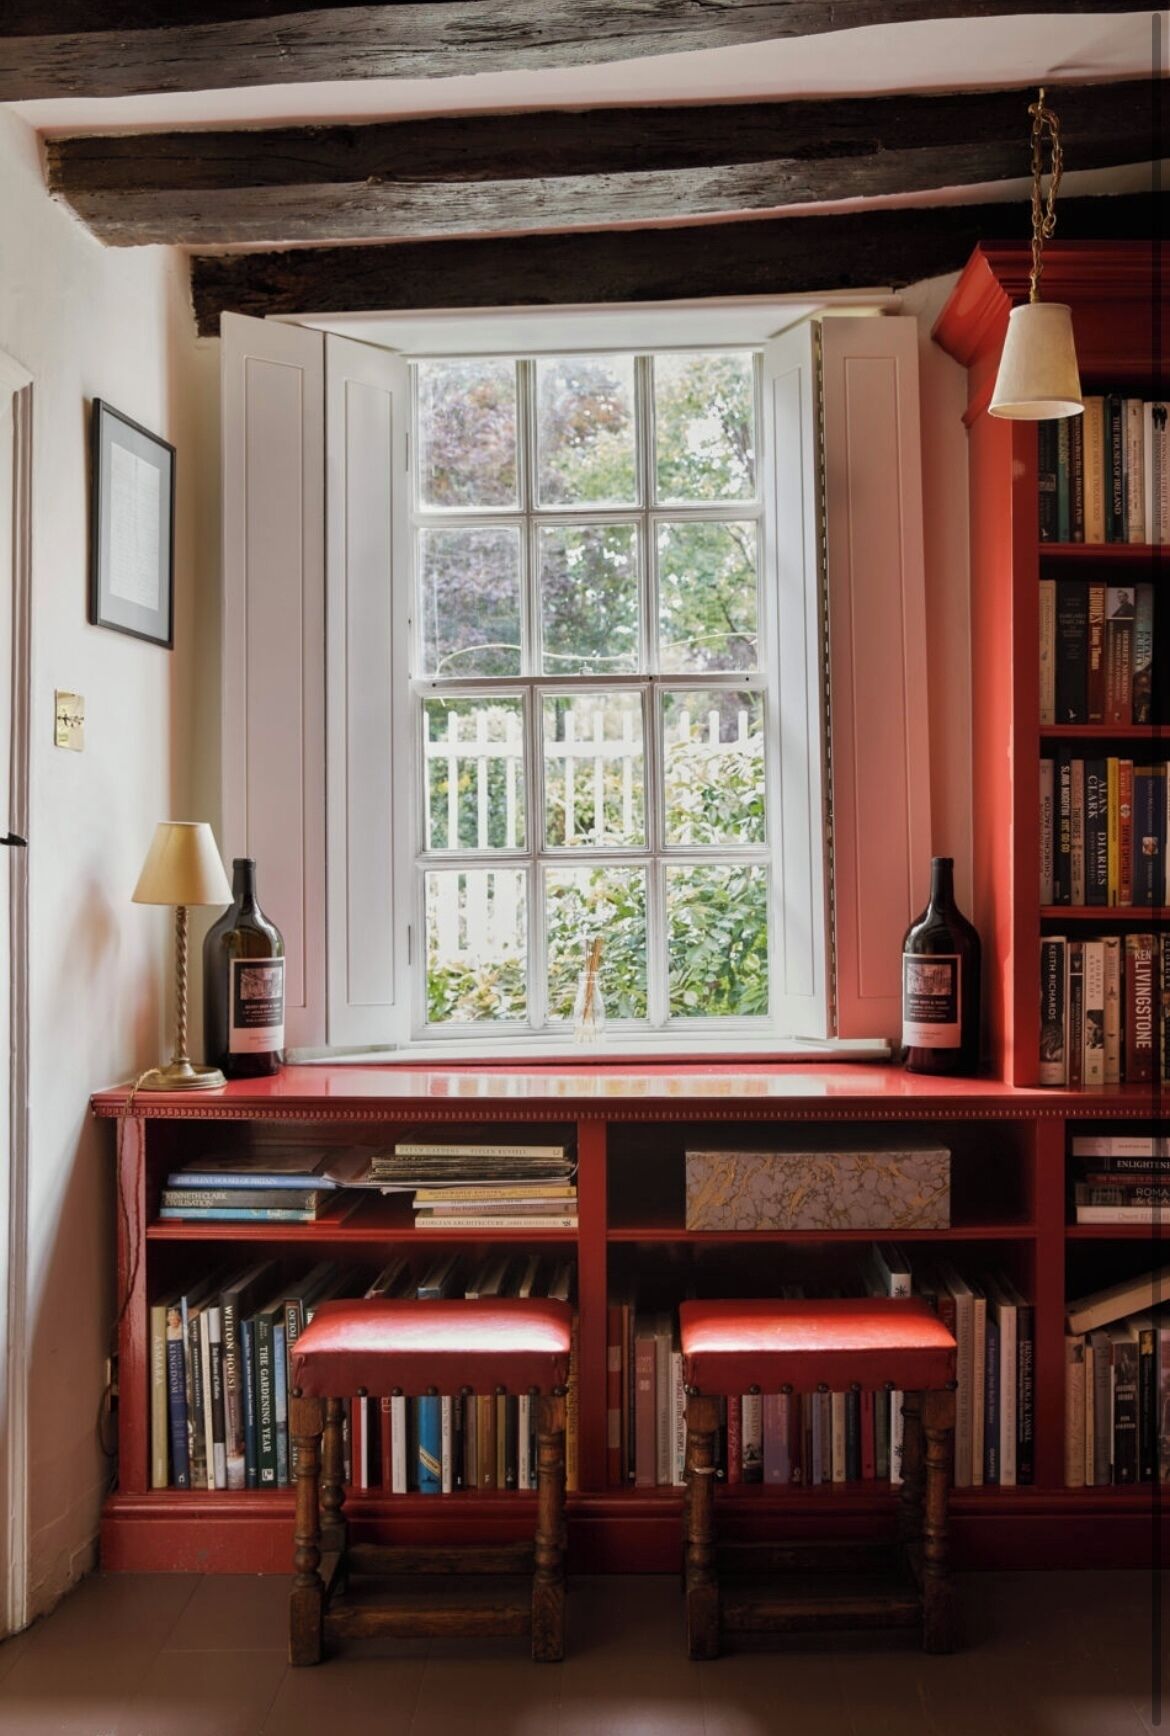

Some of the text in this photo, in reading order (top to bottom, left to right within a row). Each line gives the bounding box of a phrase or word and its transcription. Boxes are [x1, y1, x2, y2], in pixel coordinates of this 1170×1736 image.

[1112, 416, 1122, 515] THE HOUSES OF IRELAND
[1089, 587, 1105, 624] RHODES
[1088, 775, 1098, 819] CLARK
[1099, 780, 1107, 814] ALAN
[1097, 832, 1107, 885] DIARIES
[1134, 949, 1152, 960] KEN
[1048, 944, 1057, 1020] KEITH RICHARDS
[1135, 961, 1152, 1049] LIVINGSTONE
[1116, 1160, 1170, 1169] ENLIGHTEN
[165, 1192, 201, 1200] KENNETH
[453, 1218, 504, 1226] ARCHITECTURE
[287, 1309, 298, 1338] FOLIO
[960, 1306, 969, 1323] THE
[153, 1335, 164, 1385] ASMARA
[224, 1305, 236, 1391] WILTON HOUSE
[259, 1345, 268, 1365] THE
[169, 1343, 178, 1394] KINGDOM
[960, 1361, 969, 1407] COUNTRY
[260, 1368, 271, 1424] GARDENING
[262, 1427, 272, 1453] YEAR
[960, 1408, 969, 1439] HOUSE
